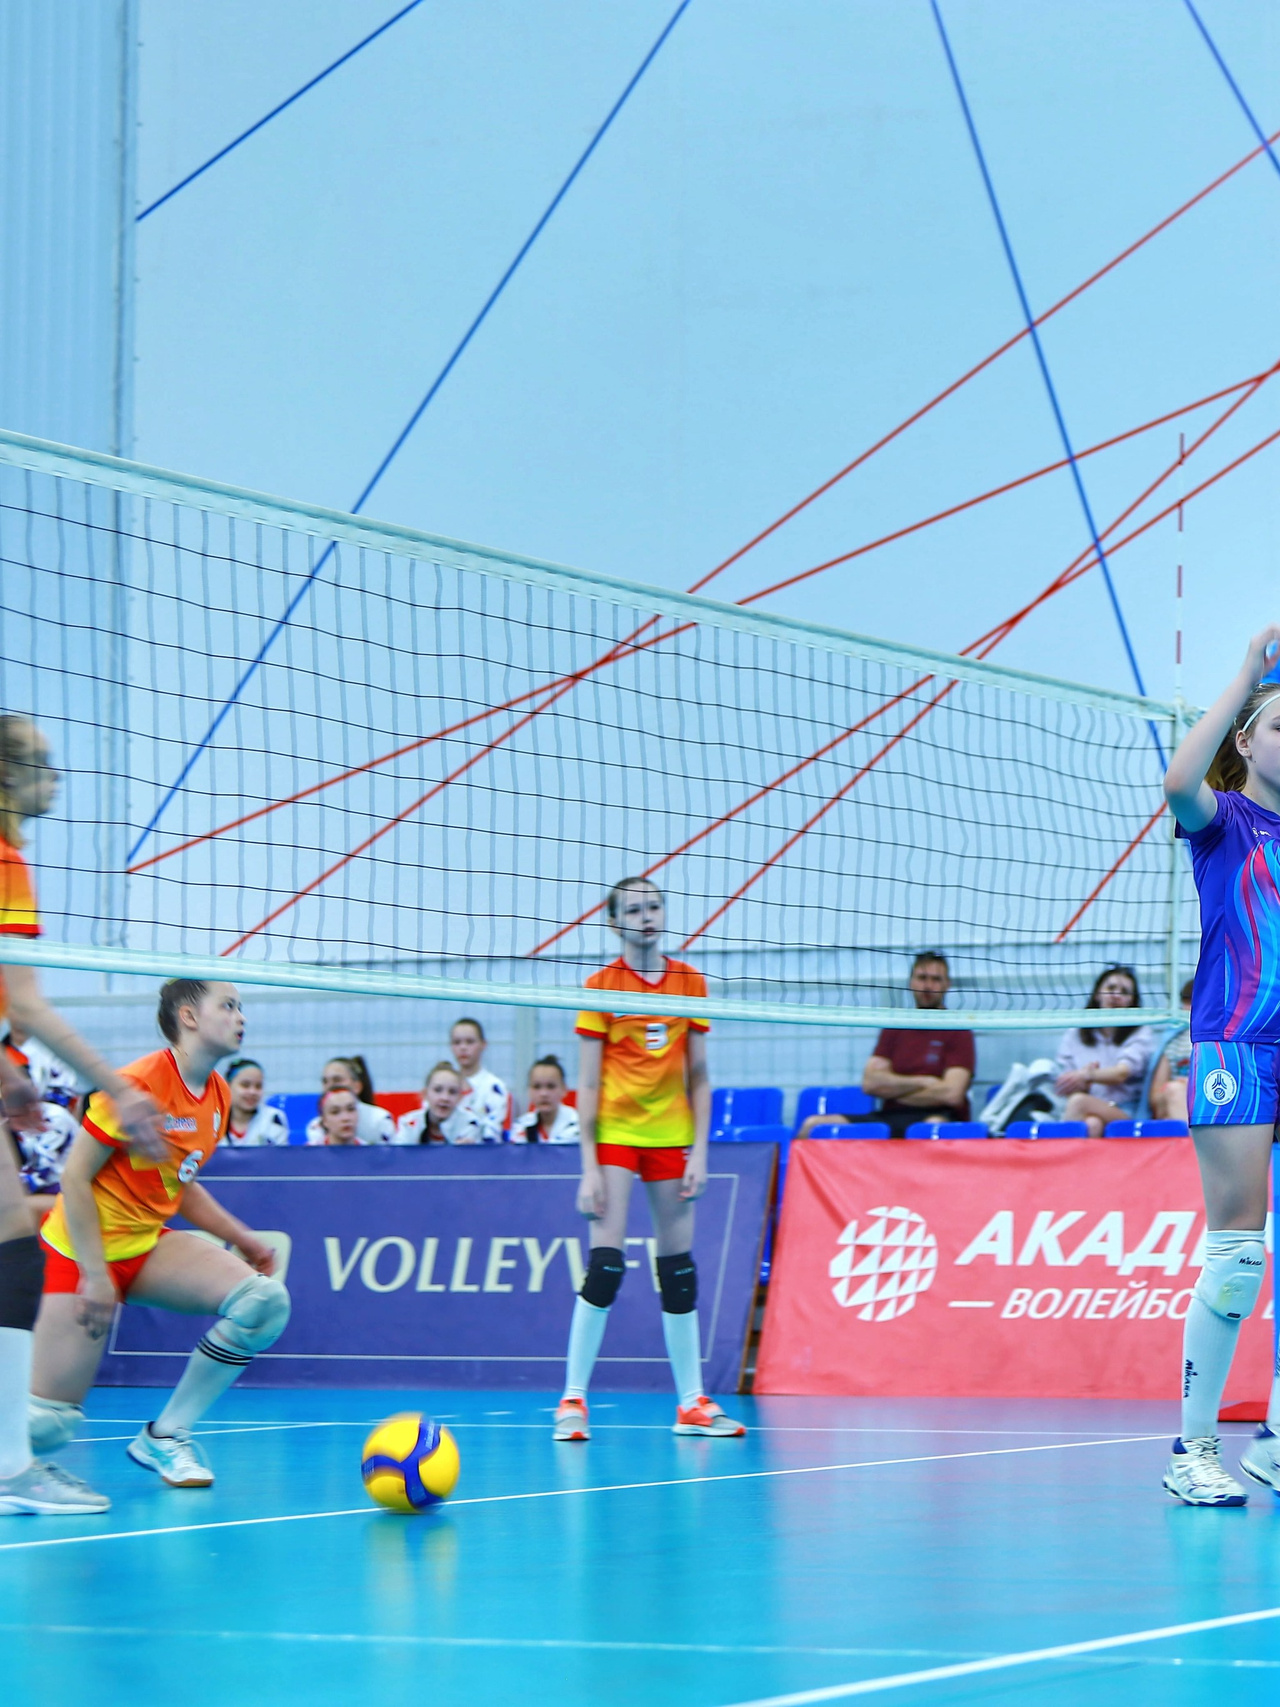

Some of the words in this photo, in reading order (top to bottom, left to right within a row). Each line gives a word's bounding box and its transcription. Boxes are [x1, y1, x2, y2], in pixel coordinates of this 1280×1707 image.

[646, 1022, 669, 1051] 3
[178, 1149, 205, 1184] 6
[954, 1210, 1272, 1276] АКАД
[323, 1236, 662, 1293] VOLLEYV
[1001, 1281, 1192, 1319] ВОЛЕЙБО
